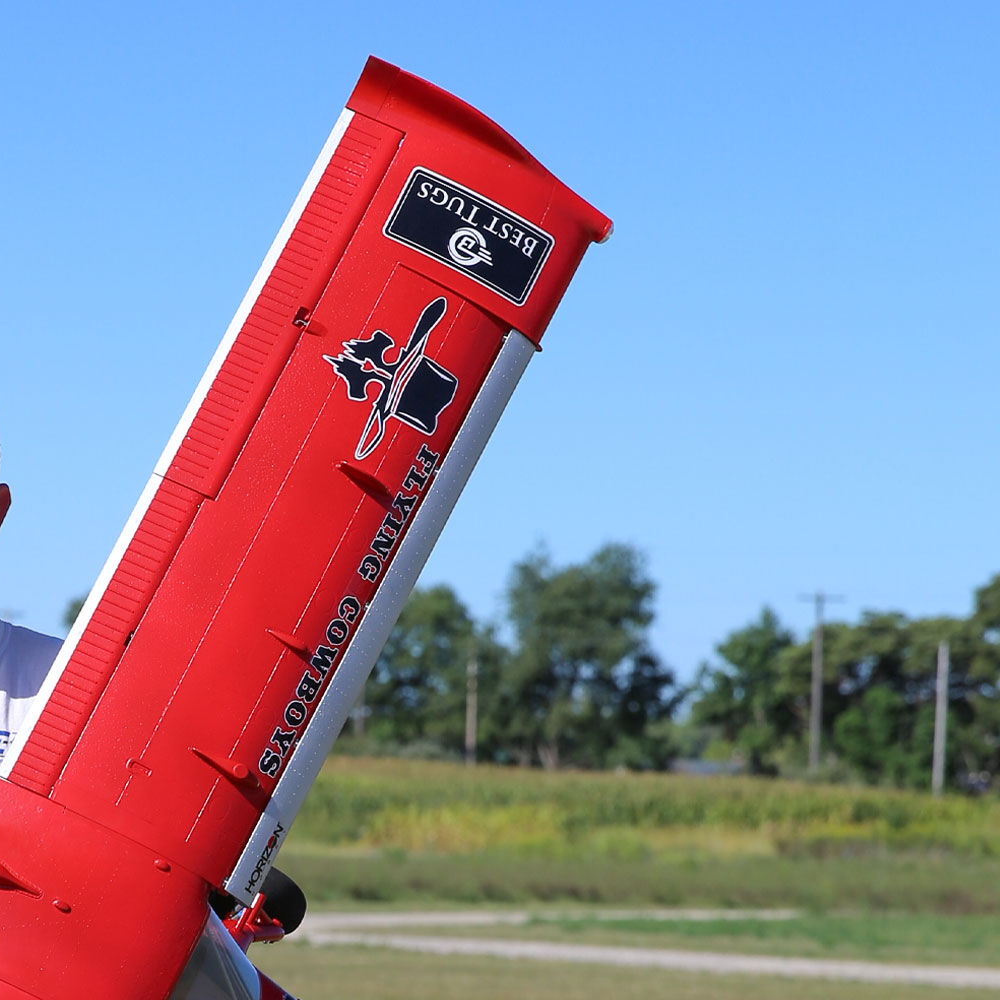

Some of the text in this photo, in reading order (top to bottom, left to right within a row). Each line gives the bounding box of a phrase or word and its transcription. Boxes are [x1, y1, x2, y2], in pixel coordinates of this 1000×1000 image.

[417, 182, 539, 259] BEST TUGS
[358, 444, 440, 583] FLYING
[258, 595, 361, 778] COWBOYS
[244, 822, 284, 895] HORIZON
